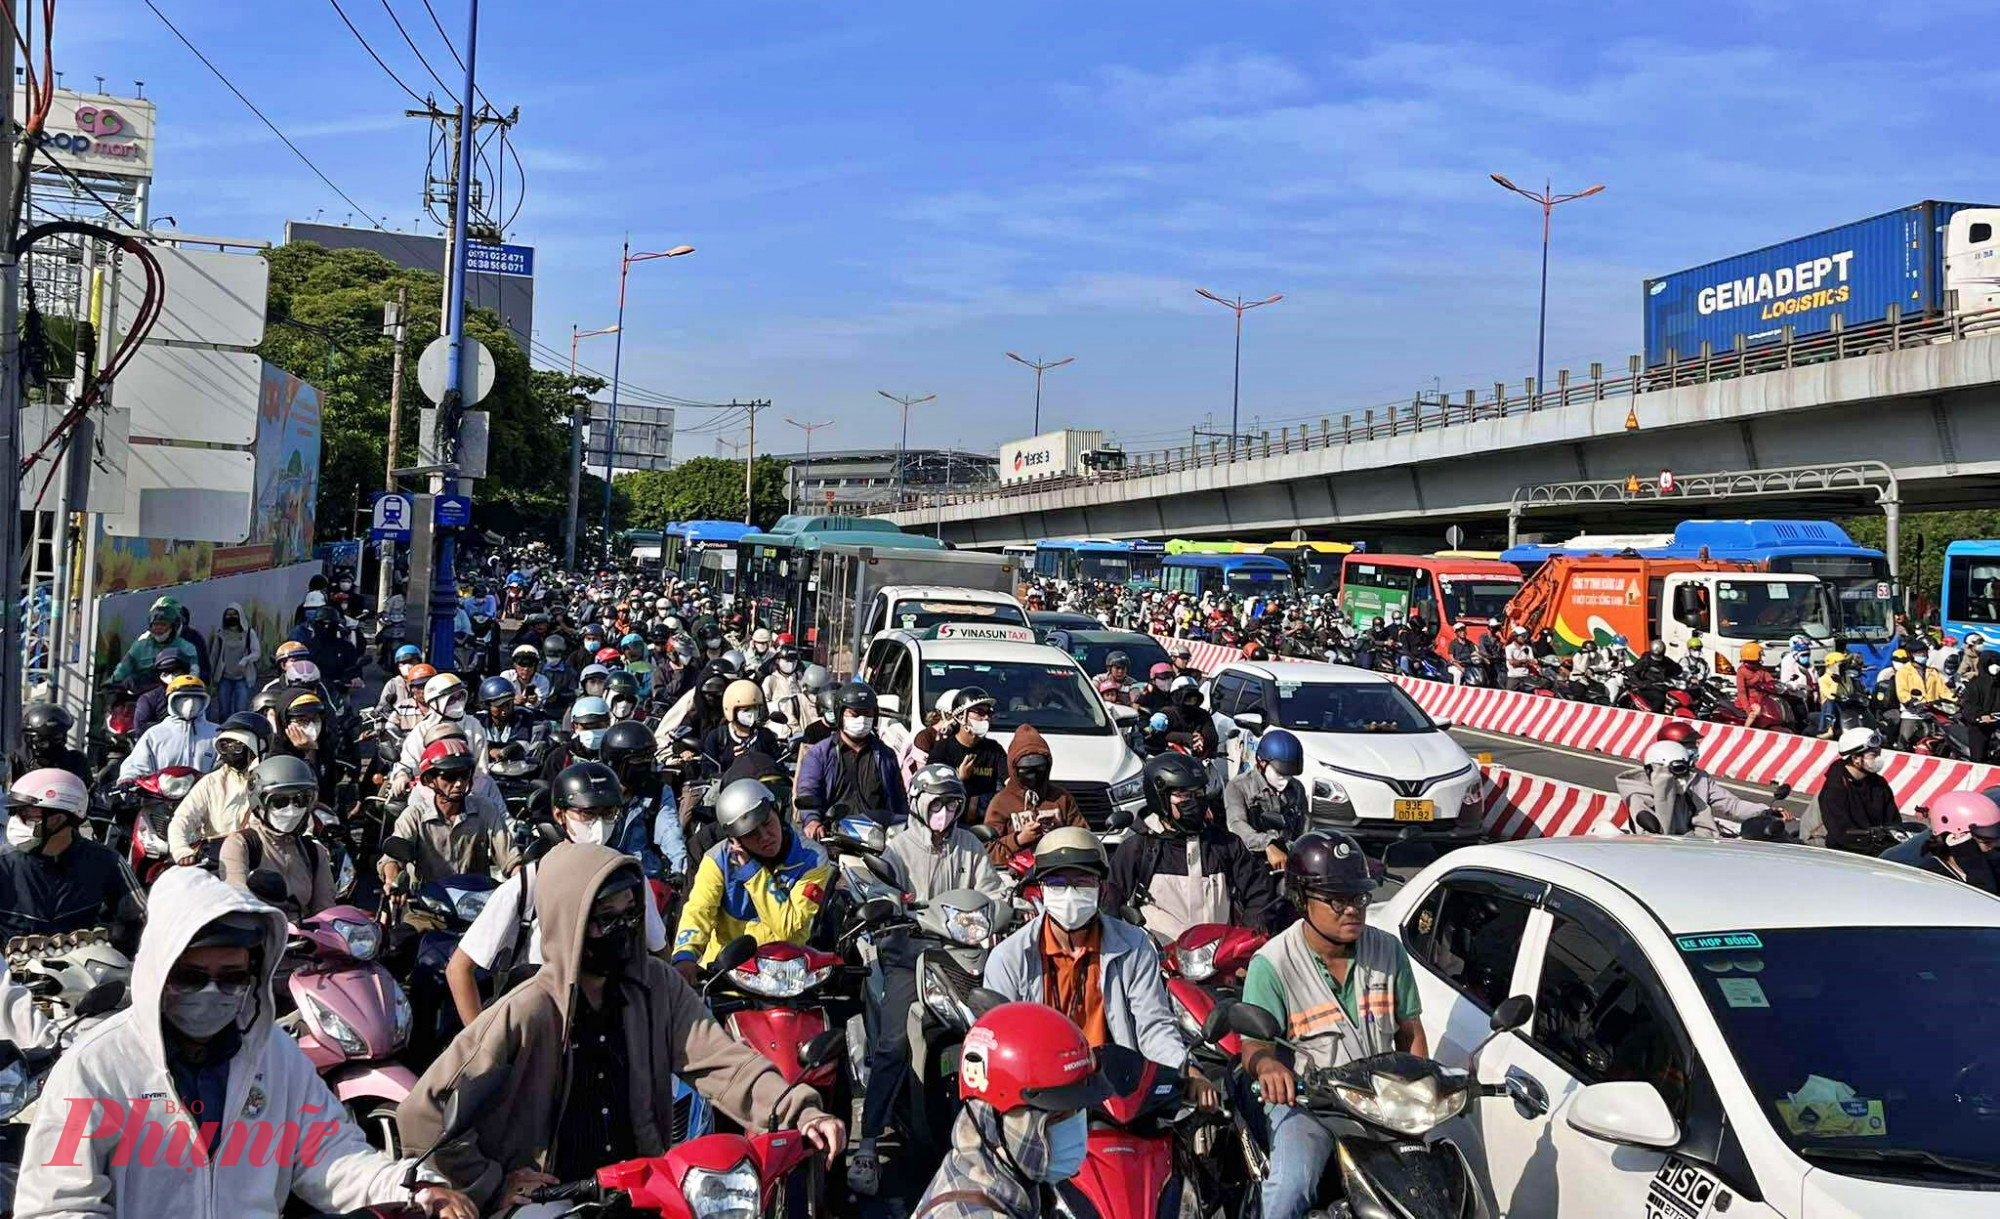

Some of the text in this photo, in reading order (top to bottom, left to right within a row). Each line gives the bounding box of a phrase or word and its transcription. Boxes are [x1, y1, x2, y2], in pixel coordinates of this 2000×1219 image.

[94, 142, 139, 158] mart
[507, 253, 524, 263] 471
[507, 262, 524, 273] 071
[1698, 250, 1853, 315] GEMADEPT
[1761, 285, 1849, 320] LOGISTICS
[1879, 585, 1889, 597] 53
[960, 628, 1027, 640] VINASUN TAXI
[1405, 800, 1423, 810] 93E
[1682, 939, 1697, 948] XE
[1658, 1156, 1712, 1205] HSC
